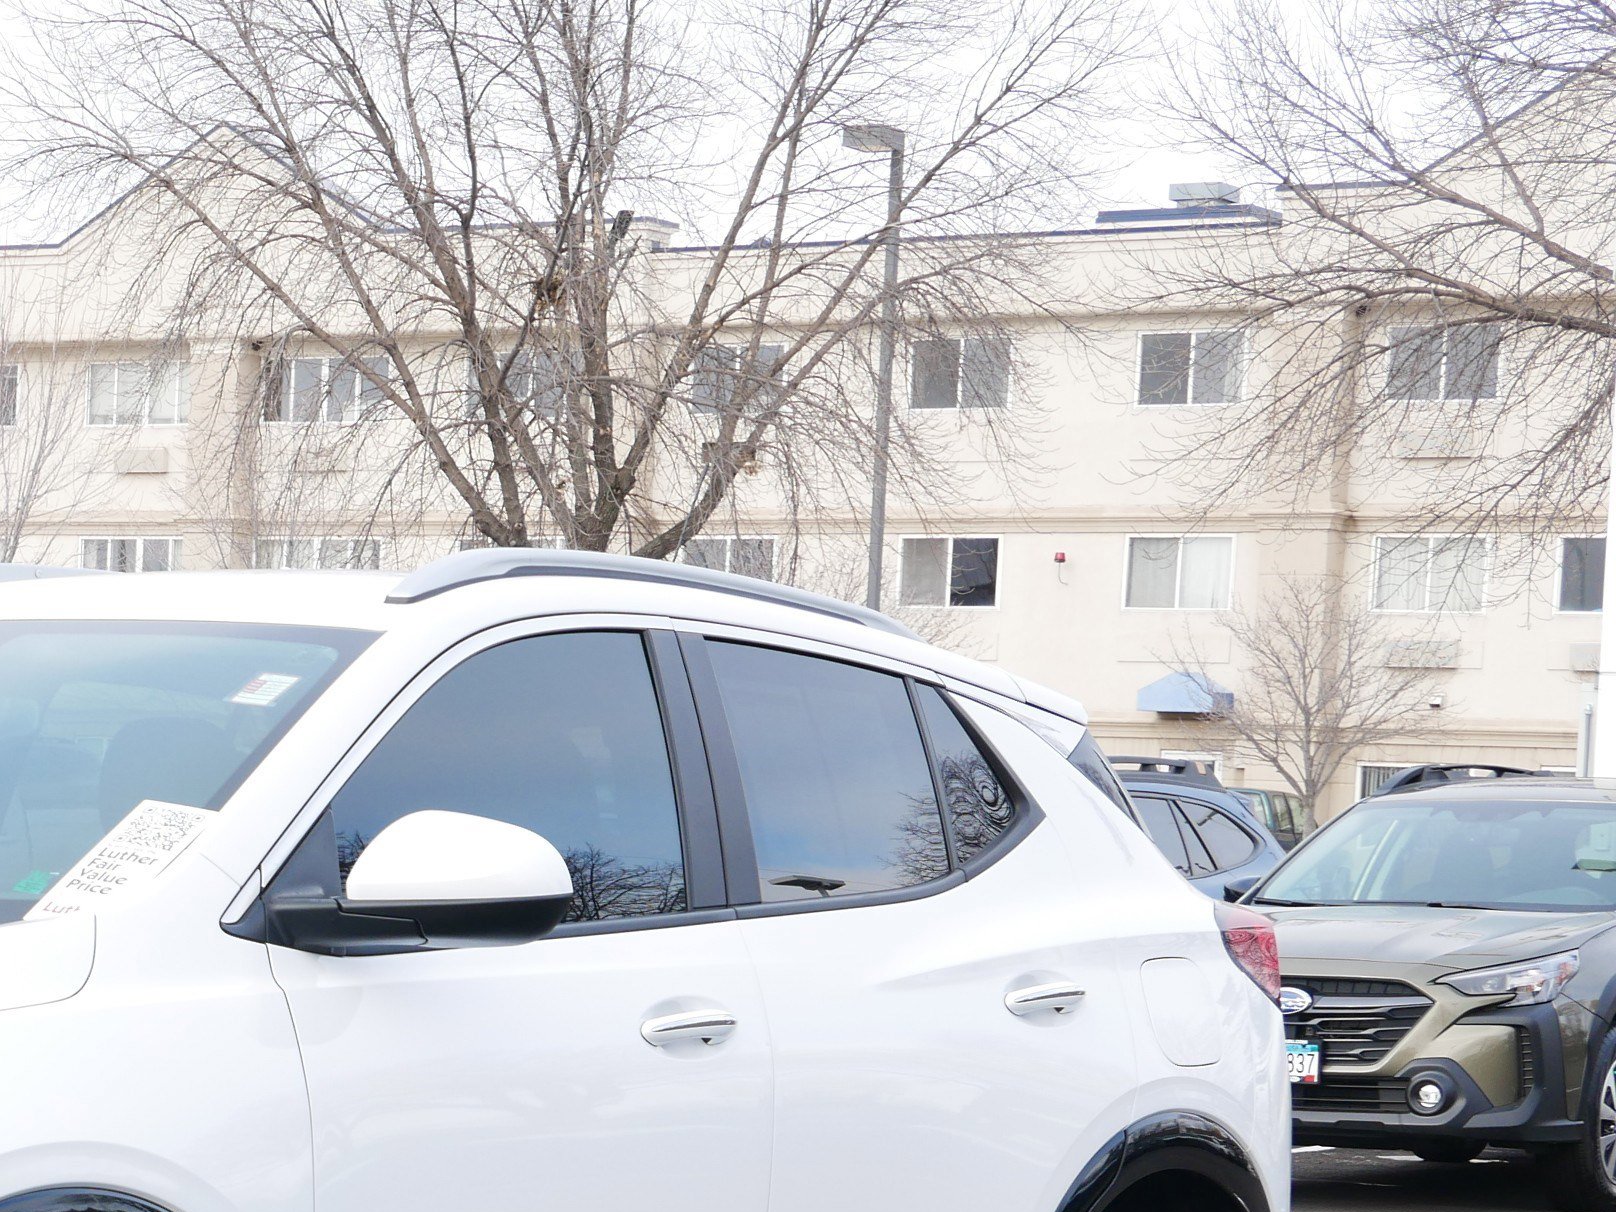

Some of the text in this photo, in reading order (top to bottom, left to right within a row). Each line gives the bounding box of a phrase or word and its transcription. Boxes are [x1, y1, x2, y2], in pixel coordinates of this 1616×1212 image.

[87, 858, 122, 872] Fair
[97, 847, 159, 867] Luther
[80, 867, 128, 886] Value
[65, 878, 113, 896] Price
